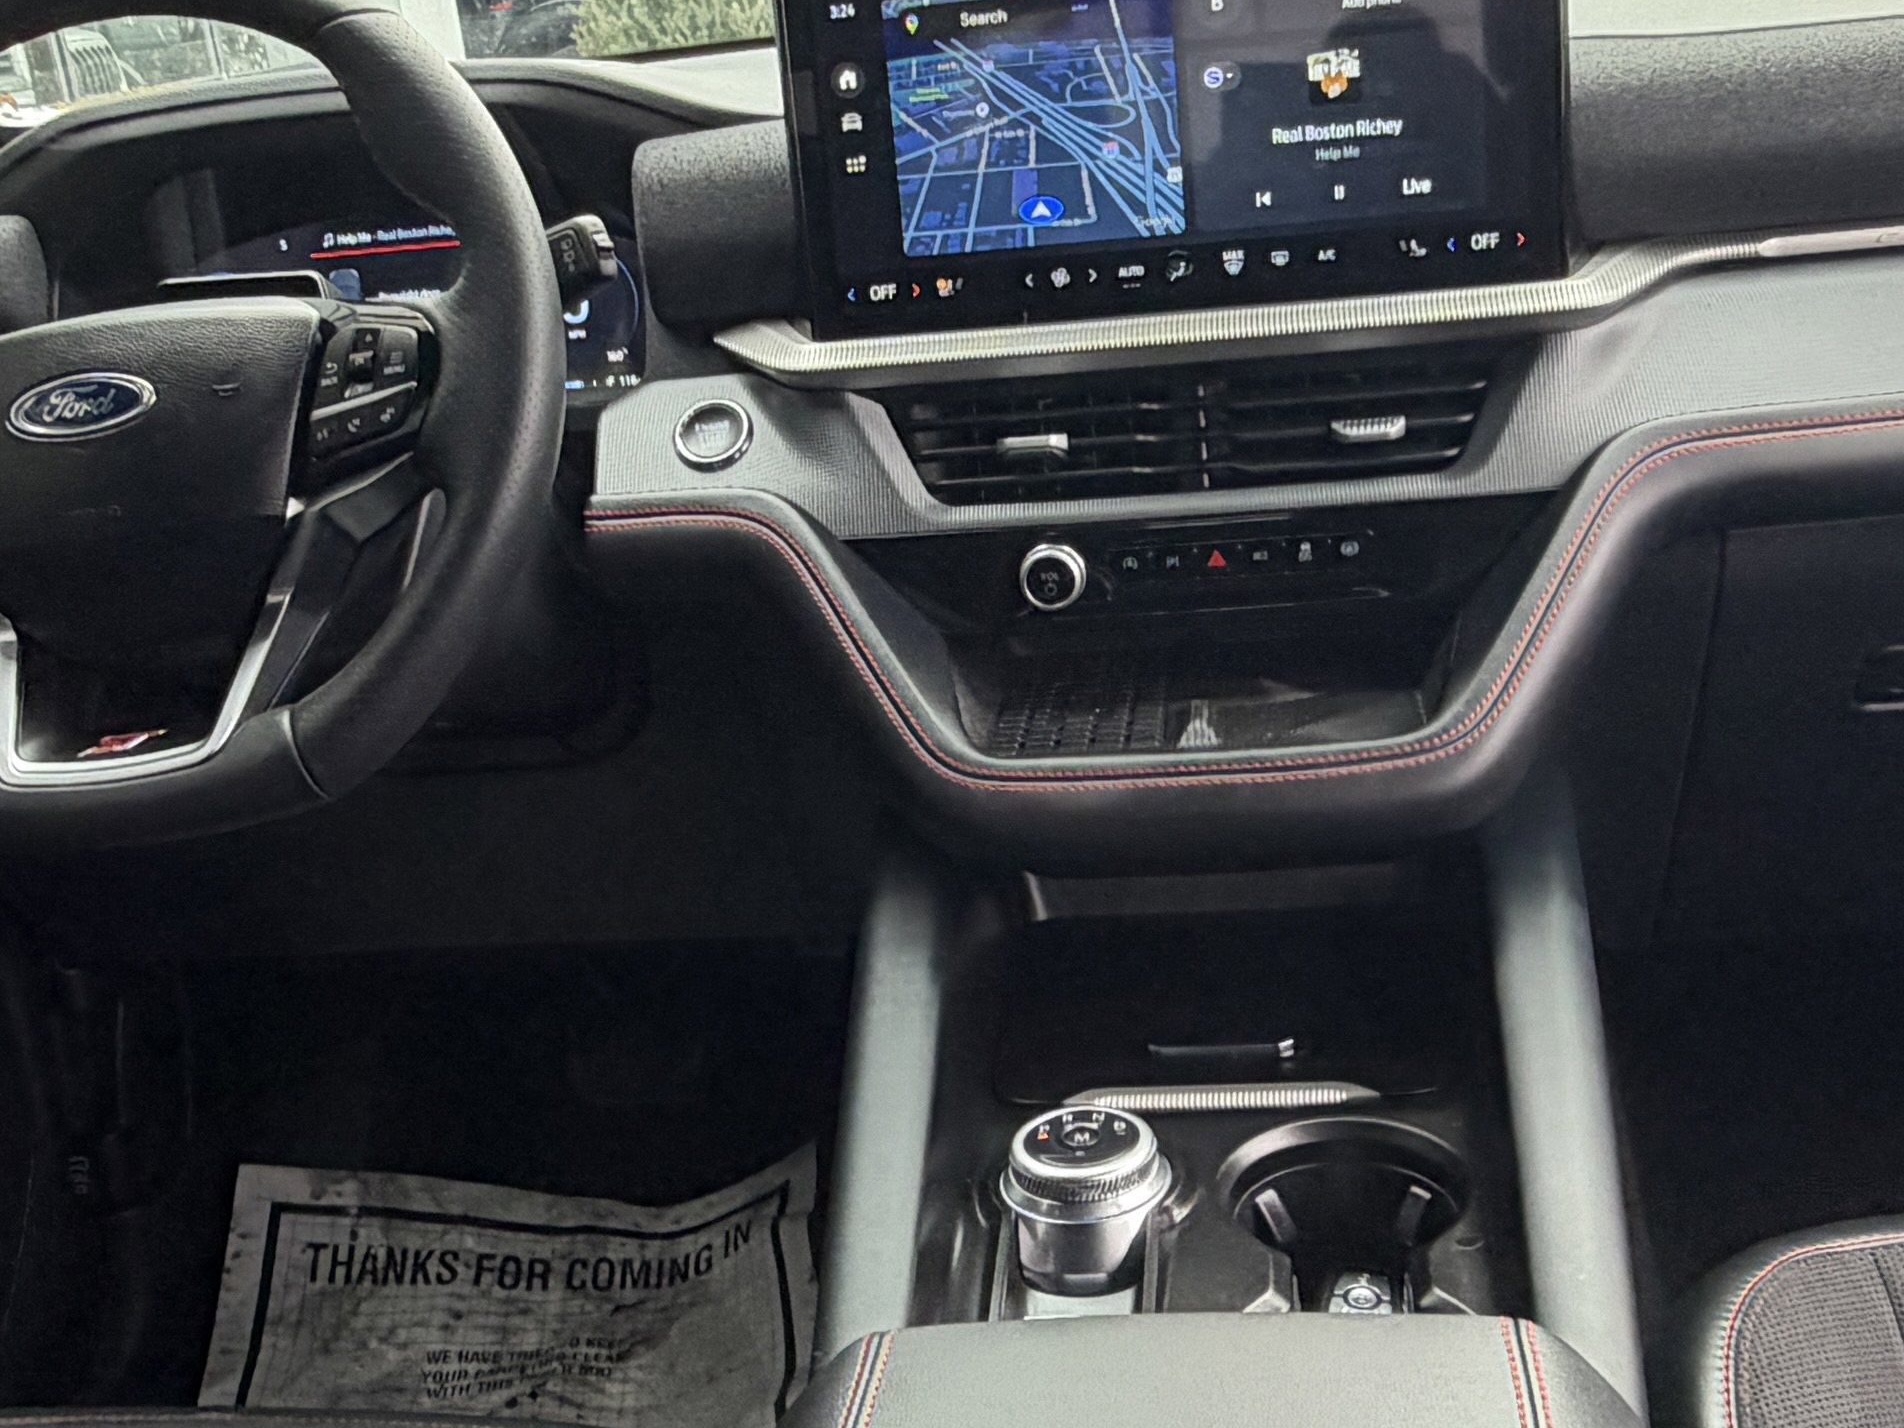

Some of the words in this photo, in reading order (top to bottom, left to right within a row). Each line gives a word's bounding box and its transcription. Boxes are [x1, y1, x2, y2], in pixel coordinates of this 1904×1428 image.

[959, 9, 1008, 28] Search
[1271, 125, 1303, 145] Real
[1304, 122, 1355, 142] Boston
[1355, 118, 1403, 140] Richey
[1315, 147, 1342, 163] Help
[1342, 145, 1360, 160] Me
[1402, 178, 1432, 196] Live
[1470, 232, 1500, 252] OFF
[1317, 248, 1336, 261] A/C
[1118, 266, 1145, 278] AUTO
[869, 283, 897, 302] OFF
[42, 384, 116, 423] Ford
[1074, 1131, 1091, 1144] M
[305, 1242, 461, 1286] THANKS
[472, 1250, 551, 1292] FOR
[564, 1243, 714, 1293] COMING
[722, 1219, 753, 1260] IN
[426, 1350, 452, 1365] WE
[458, 1350, 502, 1365] HAVE
